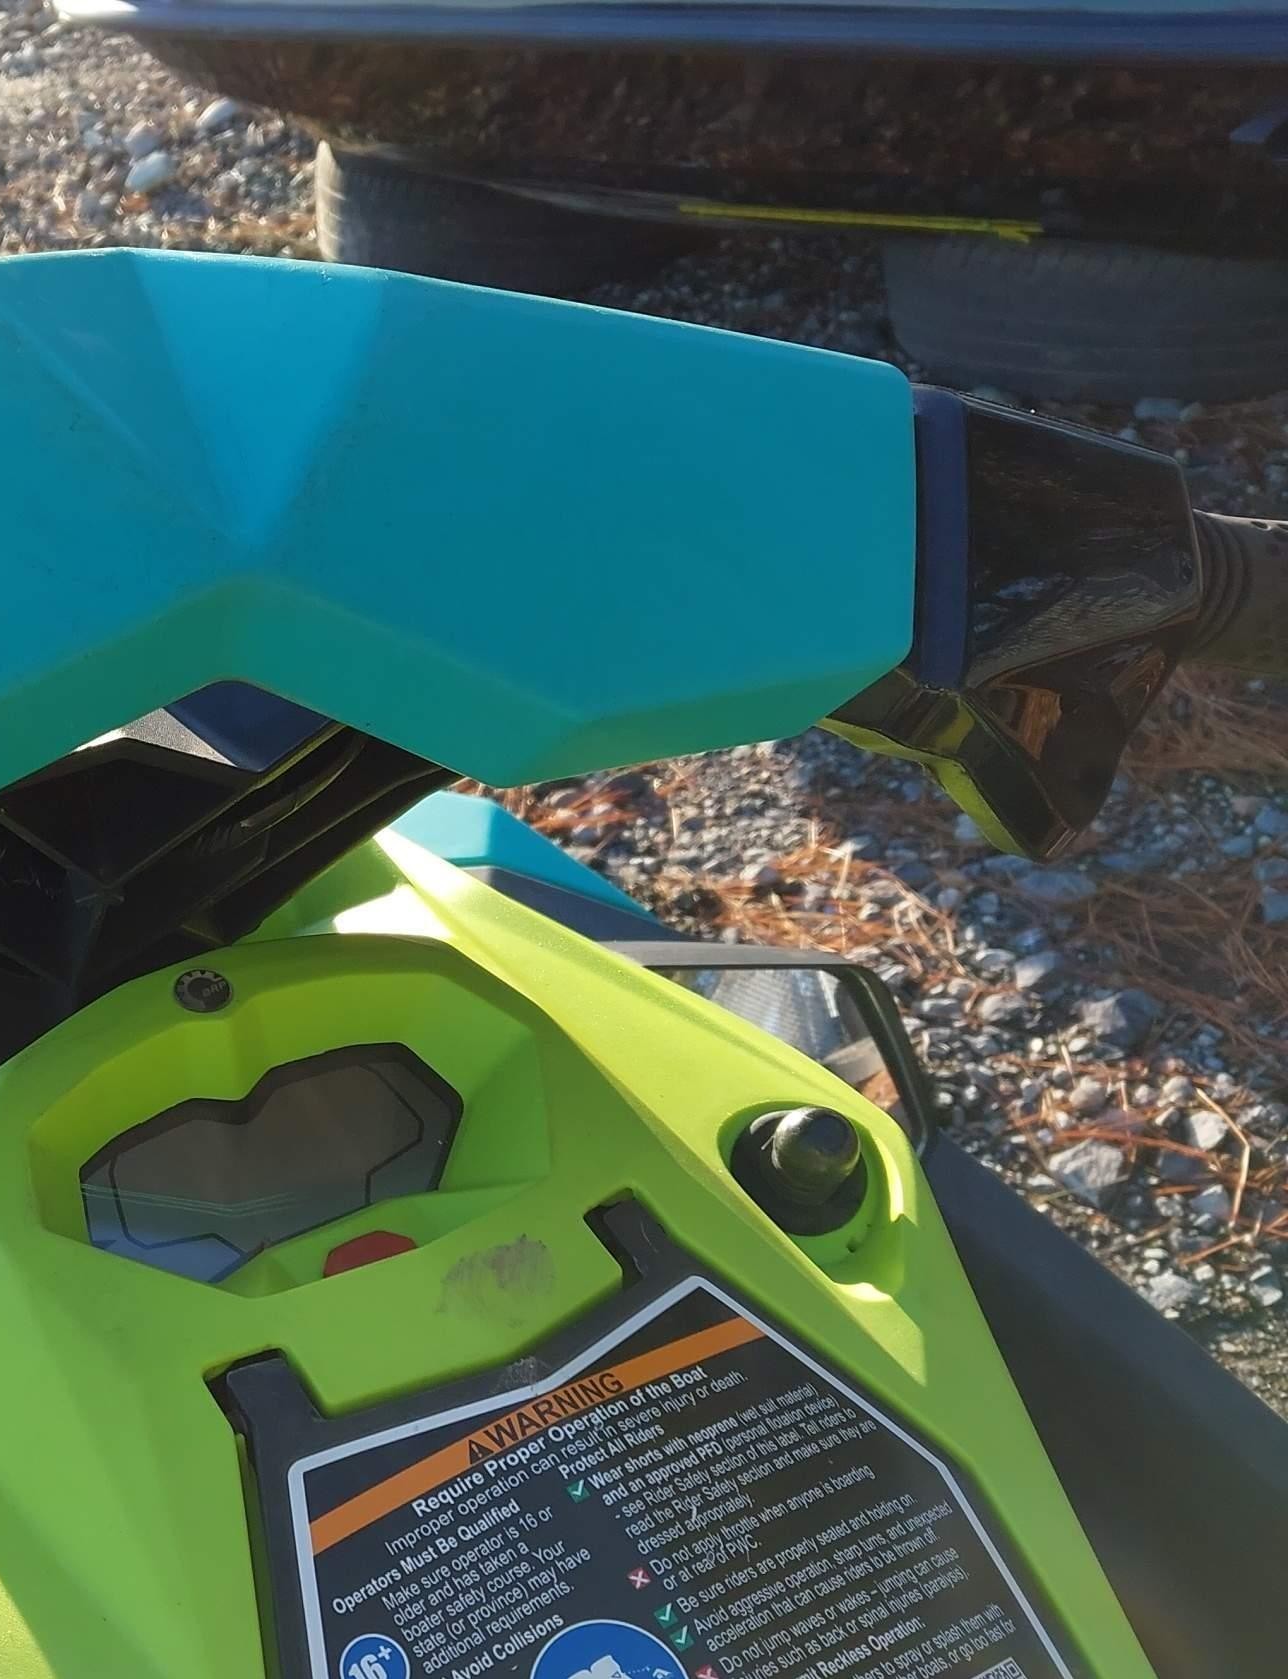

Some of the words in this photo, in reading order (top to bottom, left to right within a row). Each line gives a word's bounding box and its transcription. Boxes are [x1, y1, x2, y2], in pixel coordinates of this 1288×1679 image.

[385, 1509, 455, 1555] Improper
[457, 1470, 529, 1515] operation
[530, 1453, 561, 1474] can
[560, 1427, 603, 1459] result
[599, 1425, 618, 1439] in
[617, 1407, 662, 1432] severe
[659, 1392, 696, 1413] injury
[695, 1385, 710, 1399] or
[710, 1371, 748, 1393] death.
[412, 1472, 484, 1517] Require
[483, 1437, 546, 1477] Proper
[548, 1400, 629, 1442] Operation
[629, 1389, 647, 1406] of
[645, 1382, 672, 1399] the
[669, 1365, 708, 1389] Boat
[483, 1372, 624, 1449] WARNING
[558, 1447, 609, 1480] Protect
[607, 1437, 627, 1456] All
[624, 1424, 665, 1448] Riders
[587, 1465, 624, 1489] Wear
[624, 1449, 664, 1473] shorts
[661, 1437, 689, 1456] with
[687, 1417, 738, 1445] neoprene
[735, 1406, 762, 1426] (wet
[758, 1398, 779, 1415] suit
[776, 1382, 819, 1407] material)
[602, 1482, 629, 1506] and
[628, 1478, 646, 1493] an
[645, 1451, 699, 1485] approved
[695, 1441, 723, 1461] PFD
[721, 1420, 770, 1453] (personal
[765, 1408, 807, 1431] flotation
[804, 1393, 839, 1416] device)
[621, 1499, 646, 1517] see
[642, 1484, 676, 1506] Rider
[674, 1469, 712, 1491] Safety
[709, 1453, 747, 1477] section
[746, 1444, 759, 1460] of
[755, 1439, 778, 1456] this
[773, 1427, 804, 1448] label.
[799, 1419, 821, 1436] Tell
[819, 1412, 847, 1430] riders
[842, 1408, 856, 1419] to
[625, 1513, 655, 1539] read
[652, 1508, 675, 1524] the
[671, 1493, 704, 1514] Rider
[701, 1478, 739, 1501] Safety
[736, 1462, 775, 1486] section
[773, 1451, 795, 1470] and
[792, 1442, 820, 1461] make
[818, 1433, 842, 1450] sure
[837, 1425, 862, 1441] they
[859, 1420, 877, 1433] are
[637, 1521, 686, 1555] dressed
[684, 1493, 755, 1532] appropriately.
[649, 1557, 673, 1575] Do
[672, 1544, 694, 1565] not
[691, 1532, 724, 1555] apply
[720, 1515, 760, 1541] throttle
[757, 1503, 789, 1523] when
[786, 1487, 824, 1511] anyone
[819, 1481, 834, 1494] is
[829, 1465, 876, 1490] boarding
[333, 1569, 402, 1614] Operators
[400, 1545, 438, 1575] Must
[435, 1536, 458, 1554] Be
[457, 1498, 520, 1541] Qualified
[381, 1583, 421, 1610] Make
[420, 1565, 451, 1589] sure
[451, 1533, 505, 1571] operator
[503, 1526, 519, 1540] is
[519, 1513, 538, 1531] 16
[538, 1506, 553, 1522] or
[393, 1599, 427, 1626] older
[428, 1581, 455, 1606] and
[452, 1570, 480, 1591] has
[478, 1548, 518, 1576] taken
[517, 1542, 529, 1554] a
[400, 1609, 445, 1642] boater
[446, 1586, 486, 1616] safety
[486, 1562, 535, 1593] course.
[532, 1540, 565, 1564] Your
[412, 1632, 446, 1657] state
[446, 1618, 466, 1641] (or
[467, 1582, 529, 1630] province)
[527, 1566, 557, 1591] may
[554, 1548, 591, 1574] have
[663, 1574, 678, 1590] or
[678, 1565, 694, 1582] at
[716, 1545, 730, 1564] of
[725, 1534, 762, 1558] PWC.
[676, 1596, 699, 1613] Be
[698, 1582, 726, 1603] sure
[724, 1567, 758, 1589] riders
[756, 1558, 777, 1574] are
[774, 1537, 819, 1569] properly
[816, 1519, 851, 1546] seated
[848, 1511, 870, 1530] and
[865, 1499, 905, 1522] holding
[693, 1605, 729, 1635] Avoid
[728, 1581, 786, 1617] aggressive
[784, 1558, 837, 1589] operation,
[833, 1544, 863, 1565] sharp
[857, 1533, 891, 1552] turns,
[886, 1520, 907, 1540] and
[903, 1499, 953, 1532] unexpected
[706, 1609, 775, 1652] acceleration
[770, 1596, 797, 1617] that
[794, 1589, 816, 1606] can
[814, 1574, 846, 1597] cause
[843, 1561, 874, 1582] riders
[868, 1555, 884, 1569] to
[879, 1550, 897, 1564] be
[892, 1536, 927, 1558] thrown
[423, 1627, 486, 1674] additional
[485, 1581, 574, 1637] requirements.
[451, 1651, 493, 1679] Avoid
[492, 1614, 564, 1660] Collisions
[718, 1655, 743, 1674] Do
[742, 1641, 765, 1663] not
[759, 1630, 791, 1657] jump
[789, 1612, 826, 1637] waves
[824, 1606, 838, 1620] or
[835, 1590, 871, 1614] wakes
[873, 1568, 918, 1598] jumping
[913, 1560, 934, 1576] can
[930, 1547, 959, 1568] cause
[777, 1645, 807, 1669] such
[804, 1639, 822, 1655] as
[816, 1624, 849, 1647] back
[845, 1619, 860, 1634] or
[858, 1602, 890, 1629] spinal
[884, 1588, 923, 1614] injuries
[816, 1644, 872, 1678] Reckless
[868, 1616, 926, 1651] Operation:
[879, 1661, 896, 1675] to
[893, 1646, 925, 1670] spray
[921, 1640, 935, 1655] or
[932, 1623, 965, 1650] splash
[959, 1614, 987, 1634] them
[982, 1602, 1005, 1622] with
[948, 1649, 961, 1663] or
[959, 1643, 974, 1662] go
[969, 1635, 989, 1651] too
[983, 1623, 1006, 1643] fast
